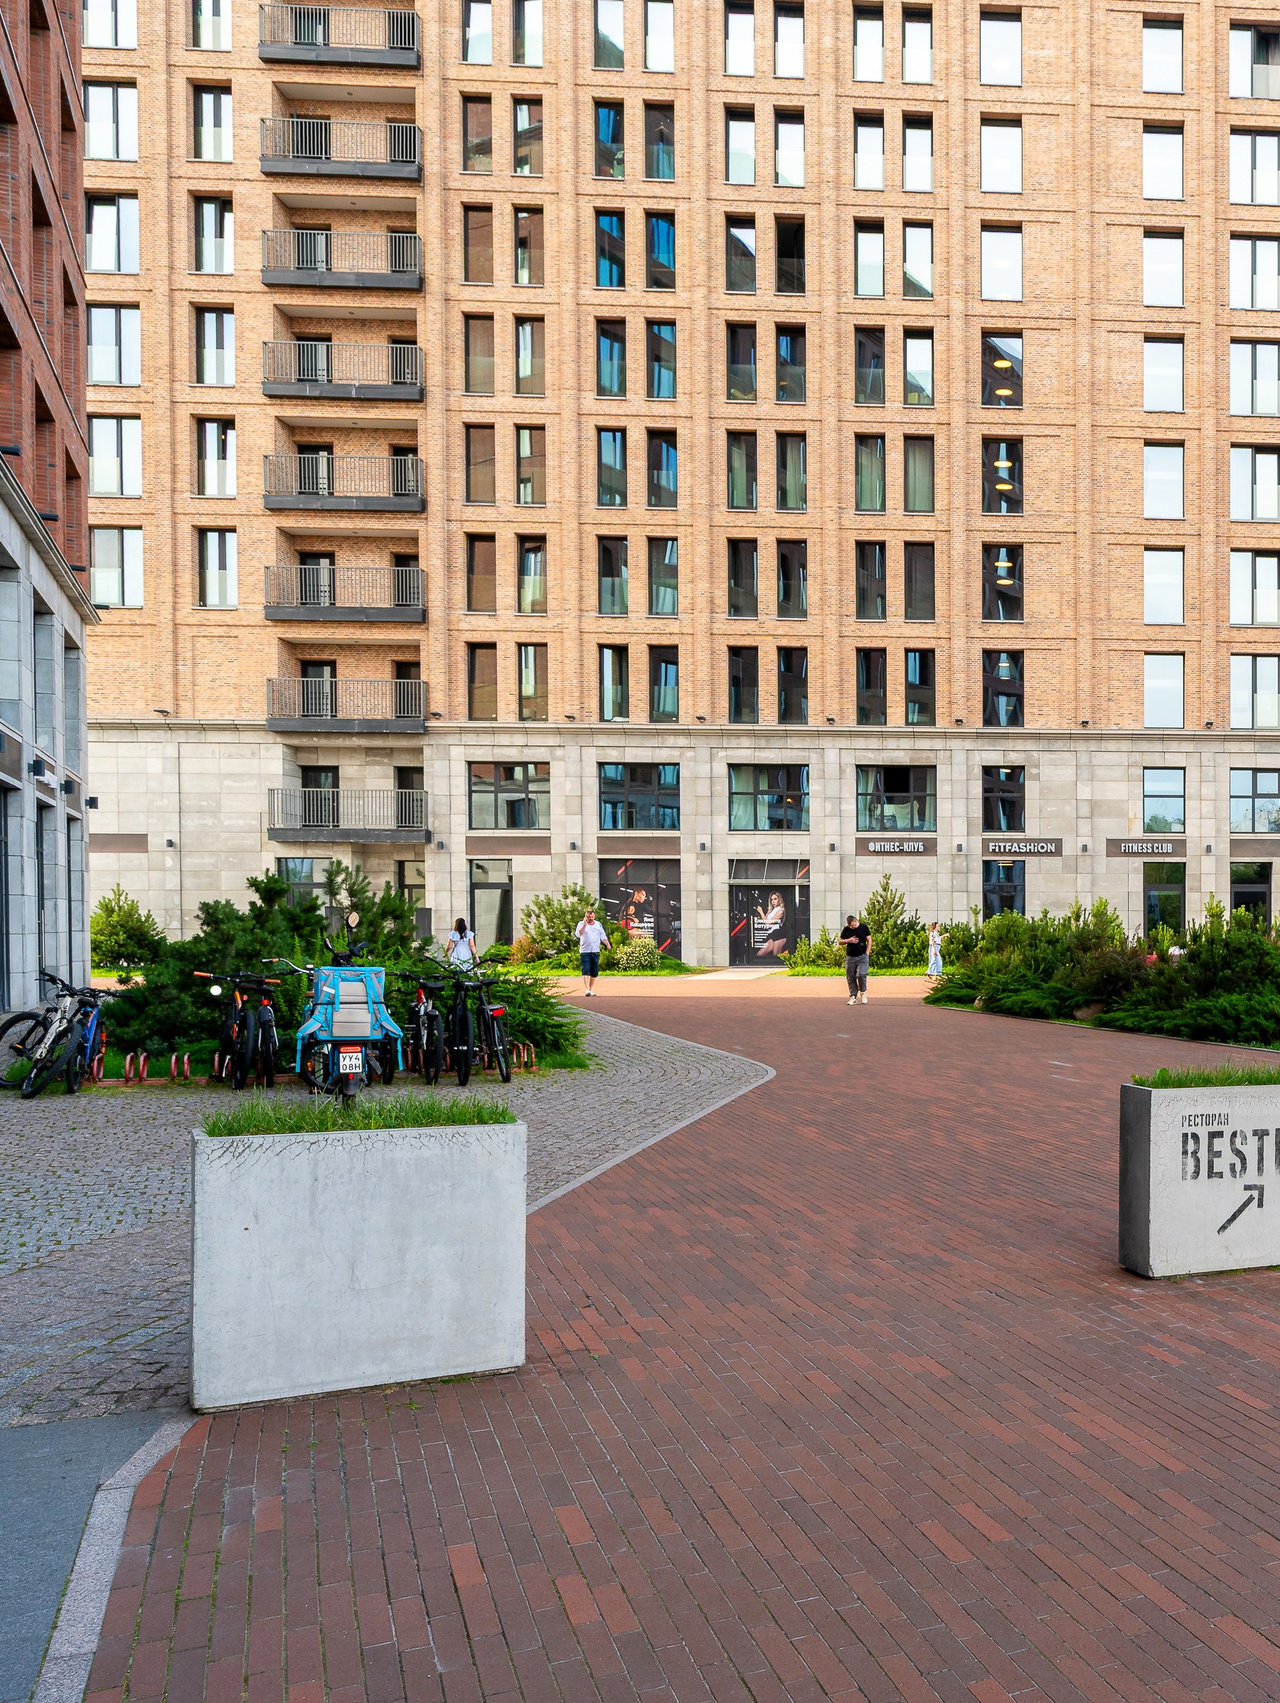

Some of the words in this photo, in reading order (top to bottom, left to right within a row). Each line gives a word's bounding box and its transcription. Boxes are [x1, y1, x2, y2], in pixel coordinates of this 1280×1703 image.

[868, 841, 924, 852] ФИТНЕС-КЛУБ
[1121, 843, 1152, 853] FITNESS
[1153, 843, 1173, 853] CLUB
[1181, 1112, 1229, 1127] РЕСТОРАН
